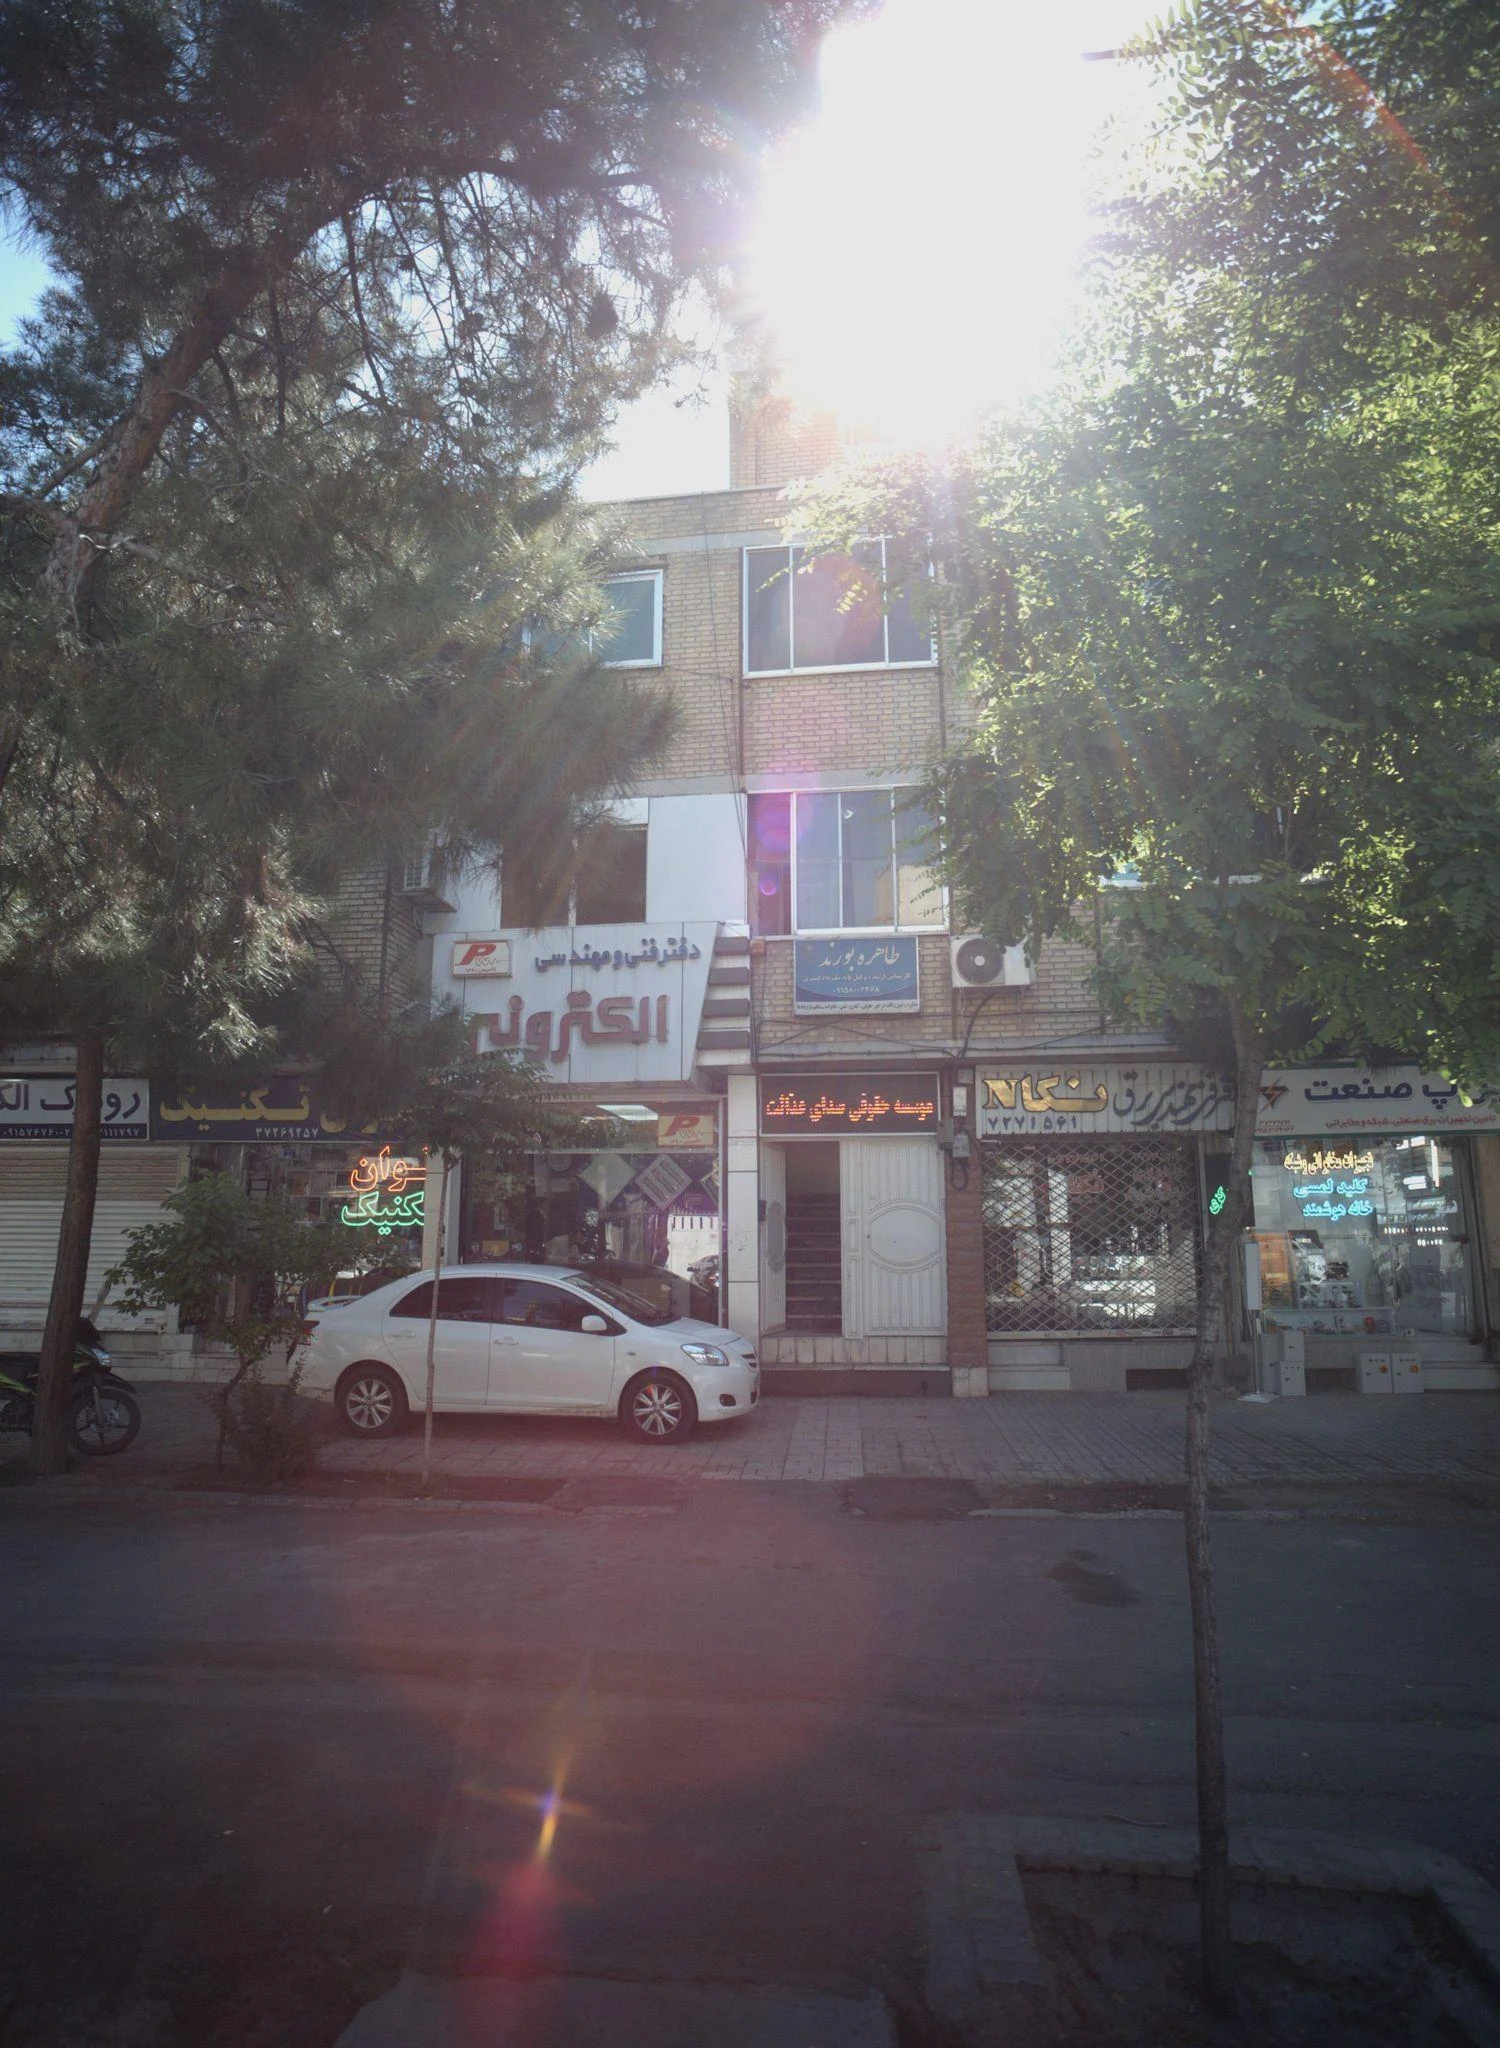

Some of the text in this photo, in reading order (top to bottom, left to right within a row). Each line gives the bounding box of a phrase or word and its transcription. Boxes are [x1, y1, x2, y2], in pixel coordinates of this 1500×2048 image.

[534, 935, 702, 973] دفتر فنی و مهندسی
[1304, 1077, 1414, 1102] صنعت
[1293, 1178, 1334, 1198] لمسی
[1336, 1178, 1368, 1198] کلید
[1302, 1200, 1374, 1221] خانه هوشمند
